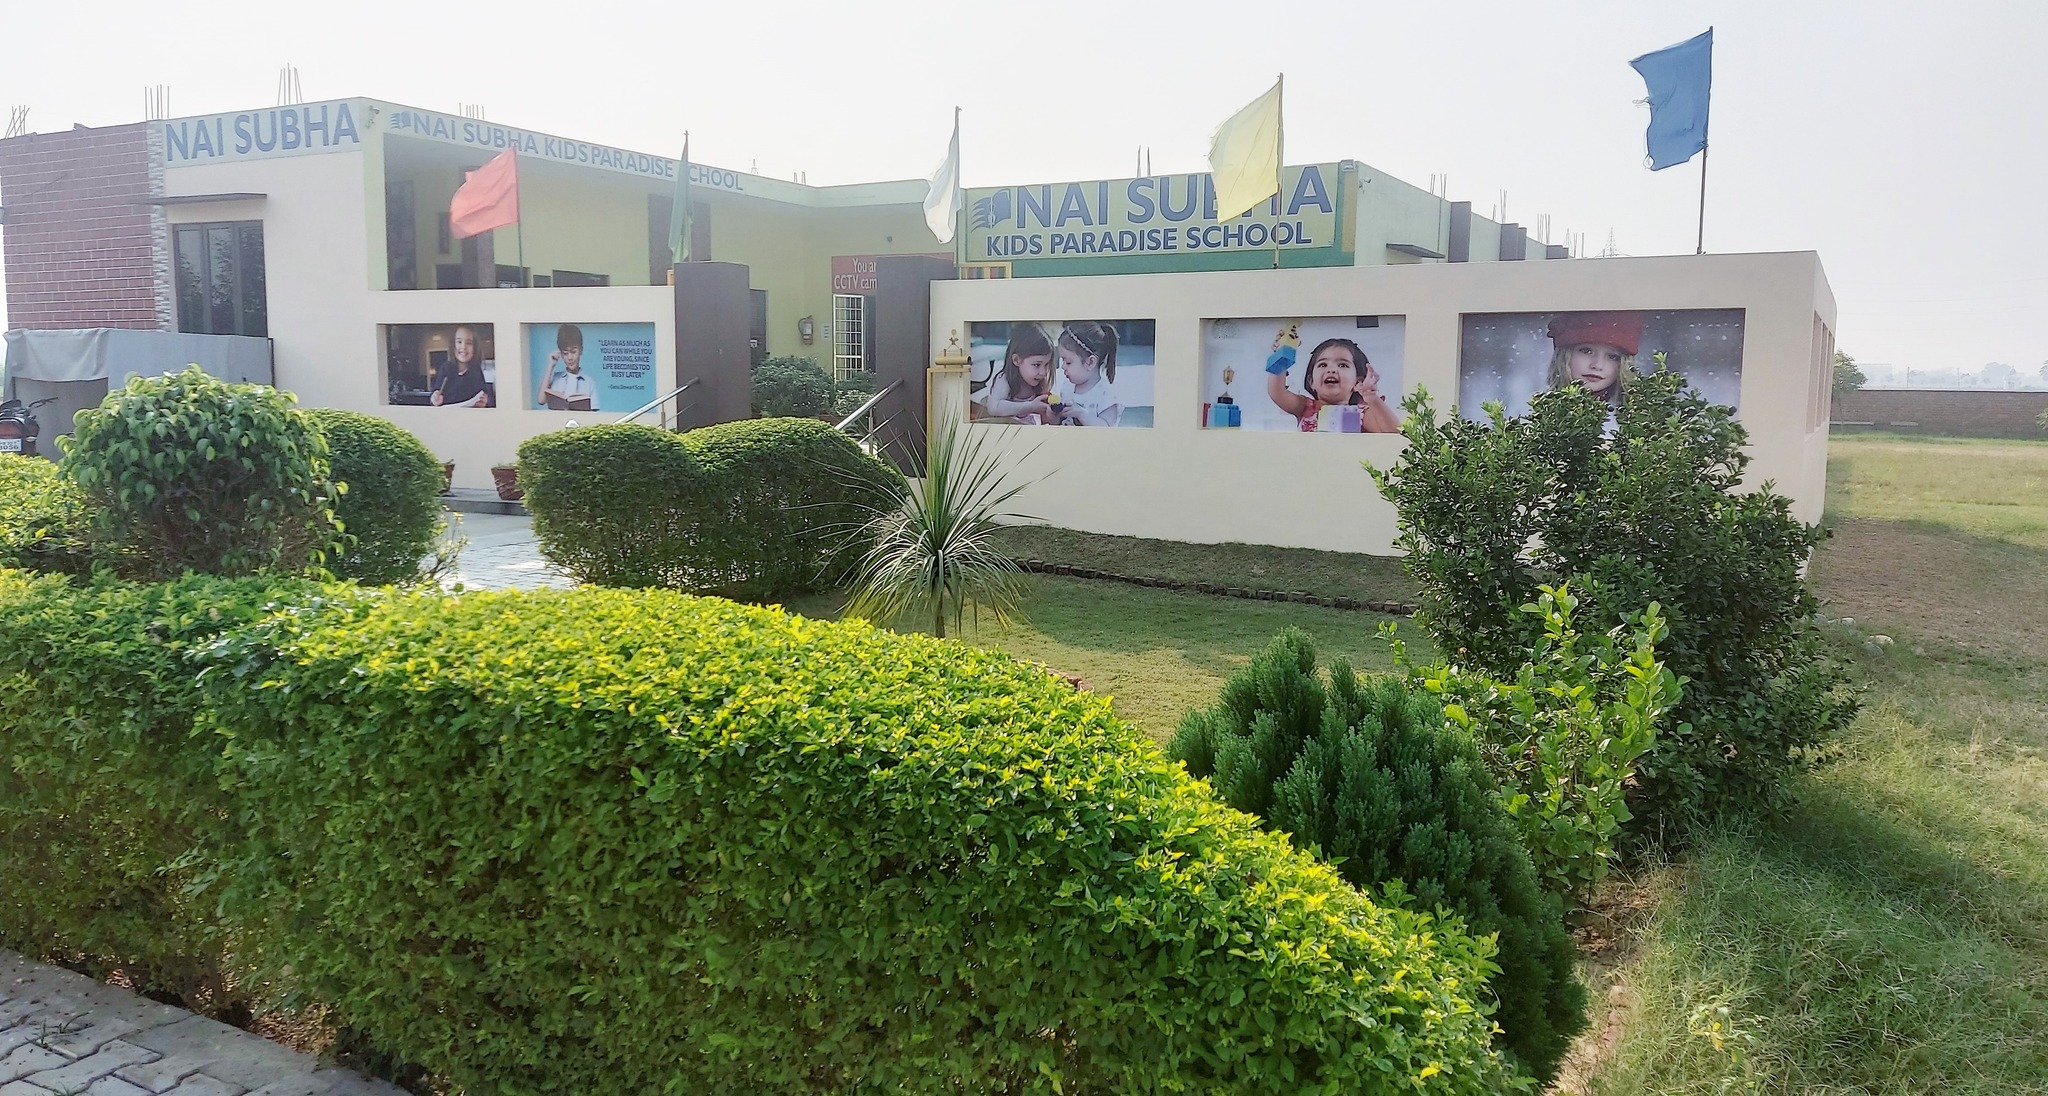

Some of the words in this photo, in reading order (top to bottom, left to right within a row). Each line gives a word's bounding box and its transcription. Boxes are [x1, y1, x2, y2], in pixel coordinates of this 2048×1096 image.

[165, 117, 224, 161] NAI
[233, 103, 360, 155] SUBHA
[413, 112, 456, 141] NAI
[463, 122, 539, 155] SUBHA
[544, 137, 588, 163] KIDS
[591, 146, 674, 178] PARADISE
[683, 164, 744, 191] CHOOL
[1016, 180, 1109, 229] NAI
[1127, 165, 1333, 222] SUA
[987, 234, 1043, 257] KIDS
[1050, 227, 1178, 255] PARADISE
[1186, 221, 1312, 250] SCHOOL
[834, 274, 859, 290] CCTV
[852, 257, 868, 273] You
